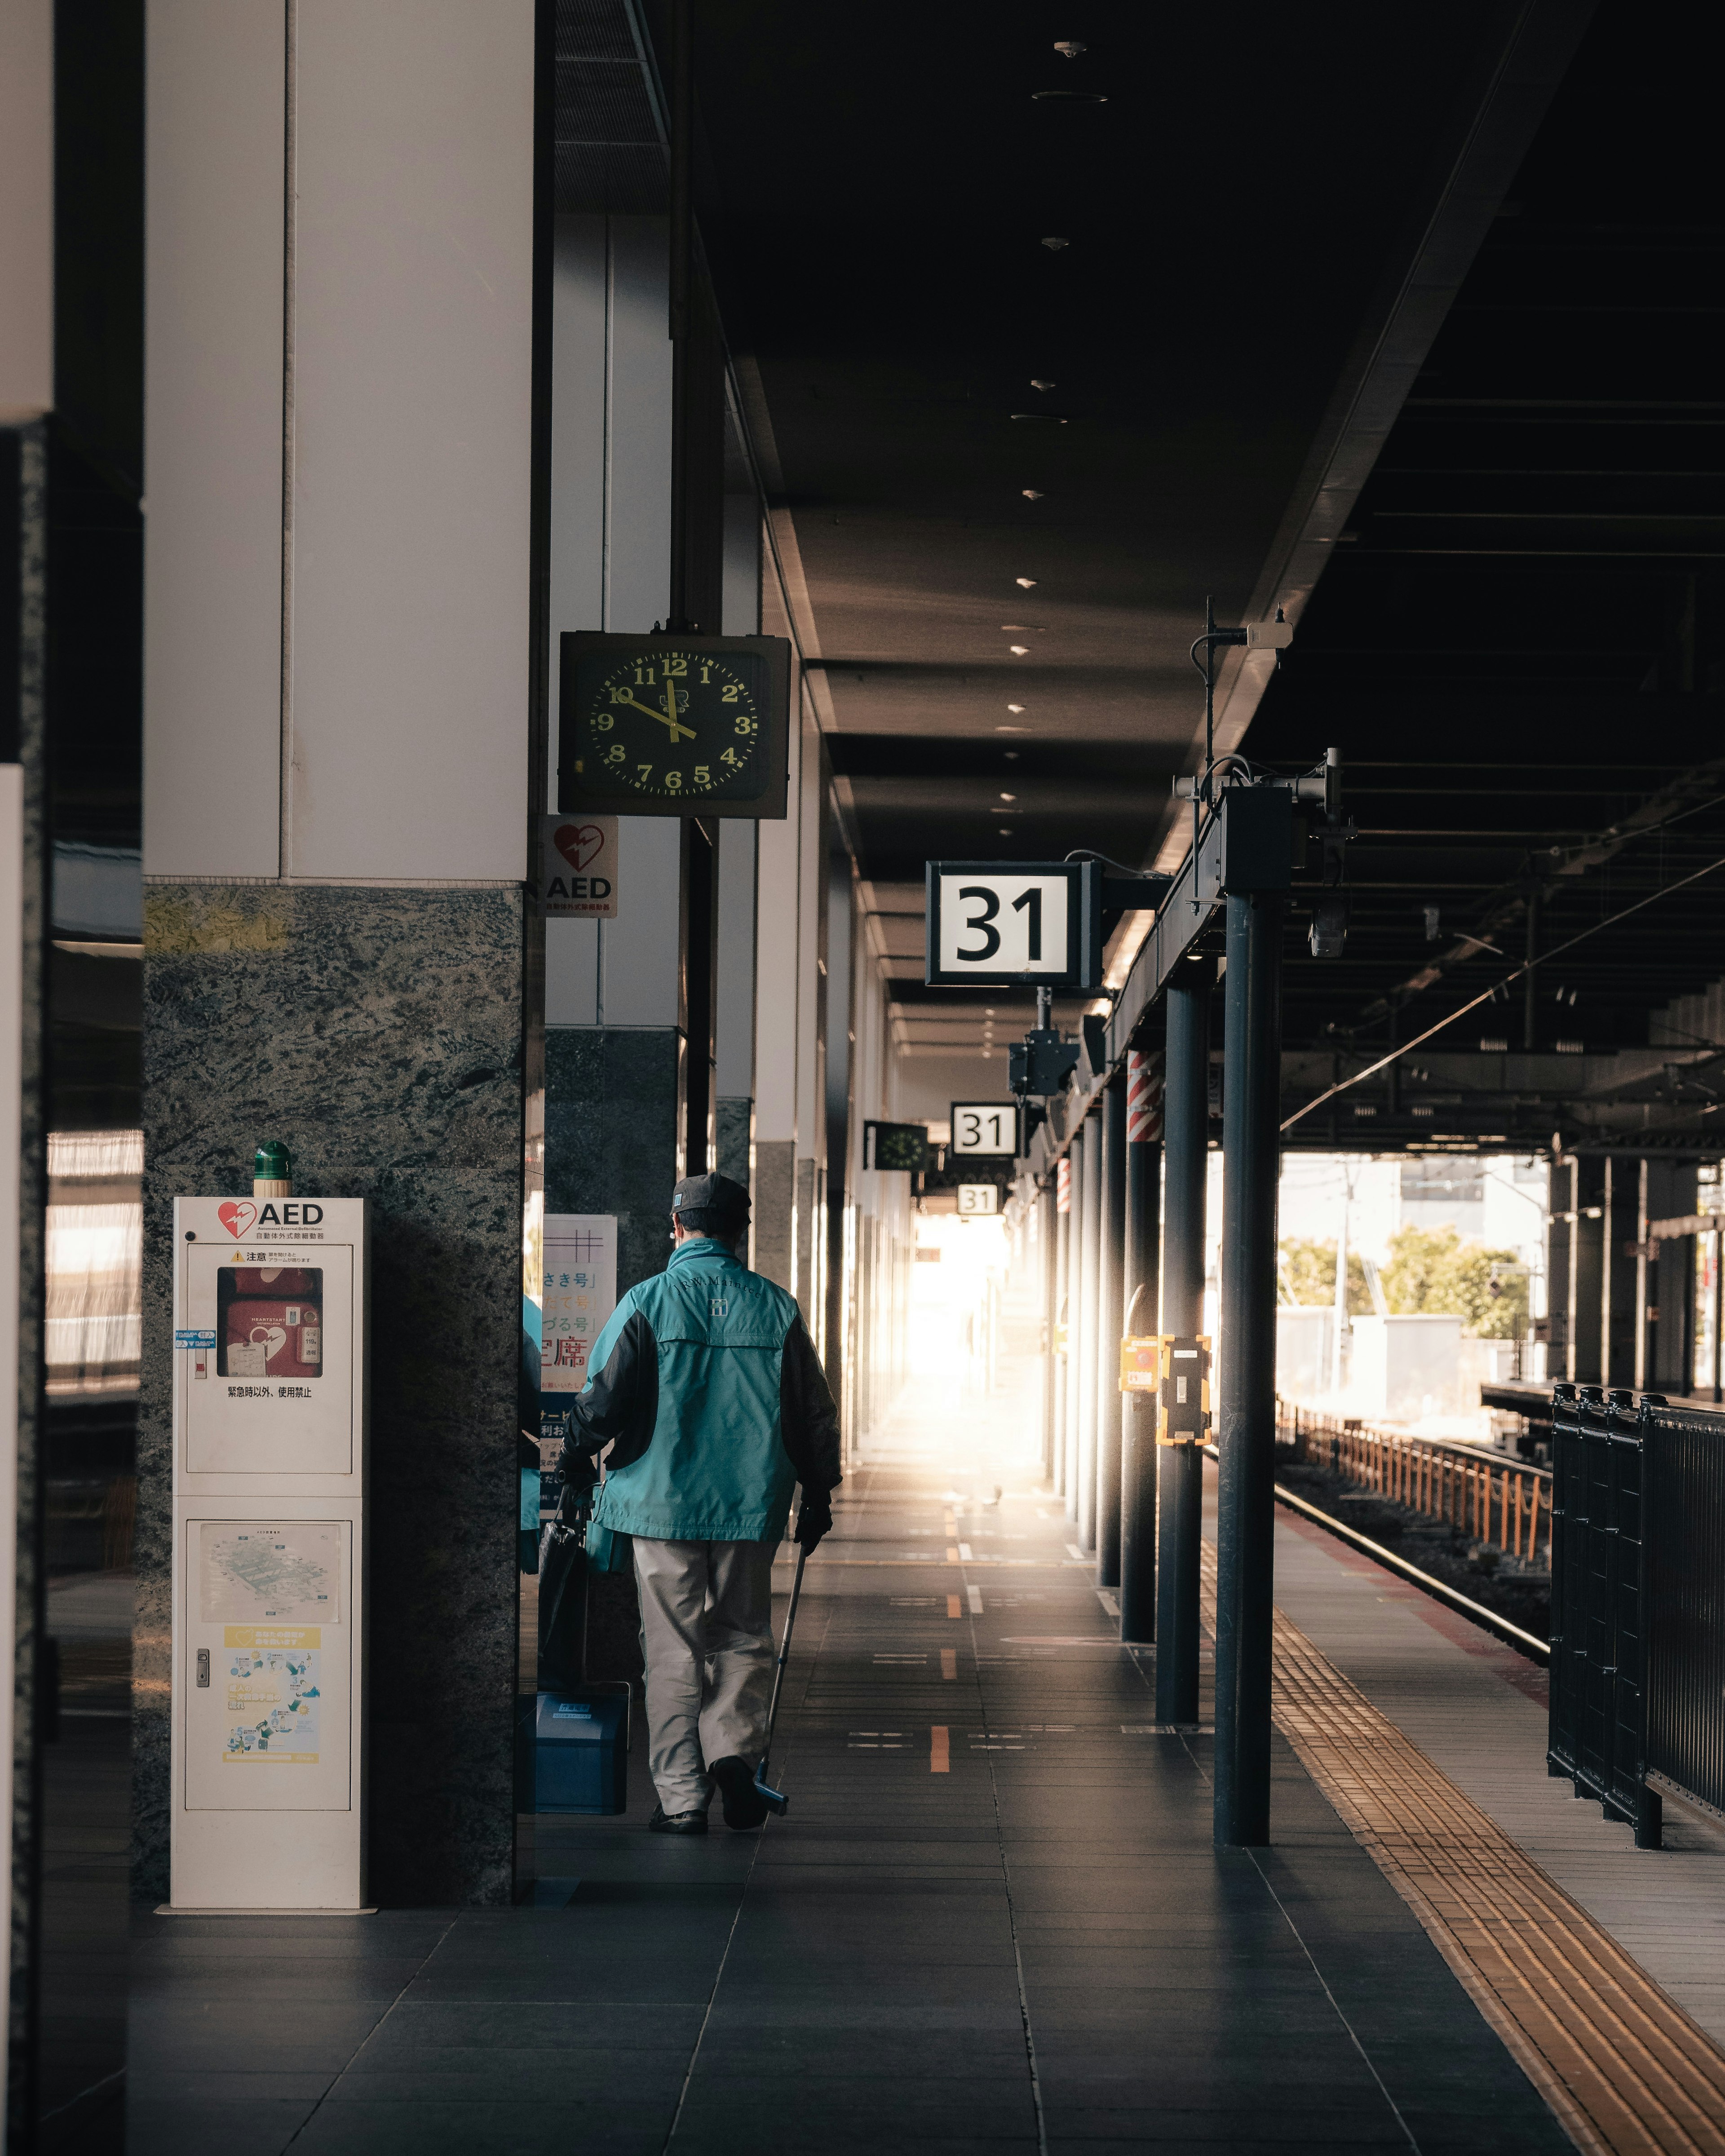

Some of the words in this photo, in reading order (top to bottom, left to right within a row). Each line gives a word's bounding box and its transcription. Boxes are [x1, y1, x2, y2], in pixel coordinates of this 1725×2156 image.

[634, 667, 656, 685] 11
[662, 659, 687, 676] 12
[700, 667, 710, 684] 1
[609, 687, 633, 704] 10
[722, 685, 738, 702] 2
[597, 714, 614, 731] 9
[734, 716, 751, 734] 3
[609, 745, 626, 762] 8
[720, 747, 737, 764] 4
[637, 764, 652, 782] 7
[665, 771, 681, 788] 6
[694, 765, 710, 783] 5
[547, 877, 611, 898] AED
[957, 886, 1042, 961] 31
[962, 1114, 1001, 1147] 31
[964, 1190, 988, 1209] 31
[258, 1203, 323, 1225] AED
[247, 1252, 266, 1261] 注意
[228, 1387, 312, 1398] 緊急時以外、使用禁止
[271, 1709, 278, 1718] 4
[237, 1727, 243, 1736] 5
